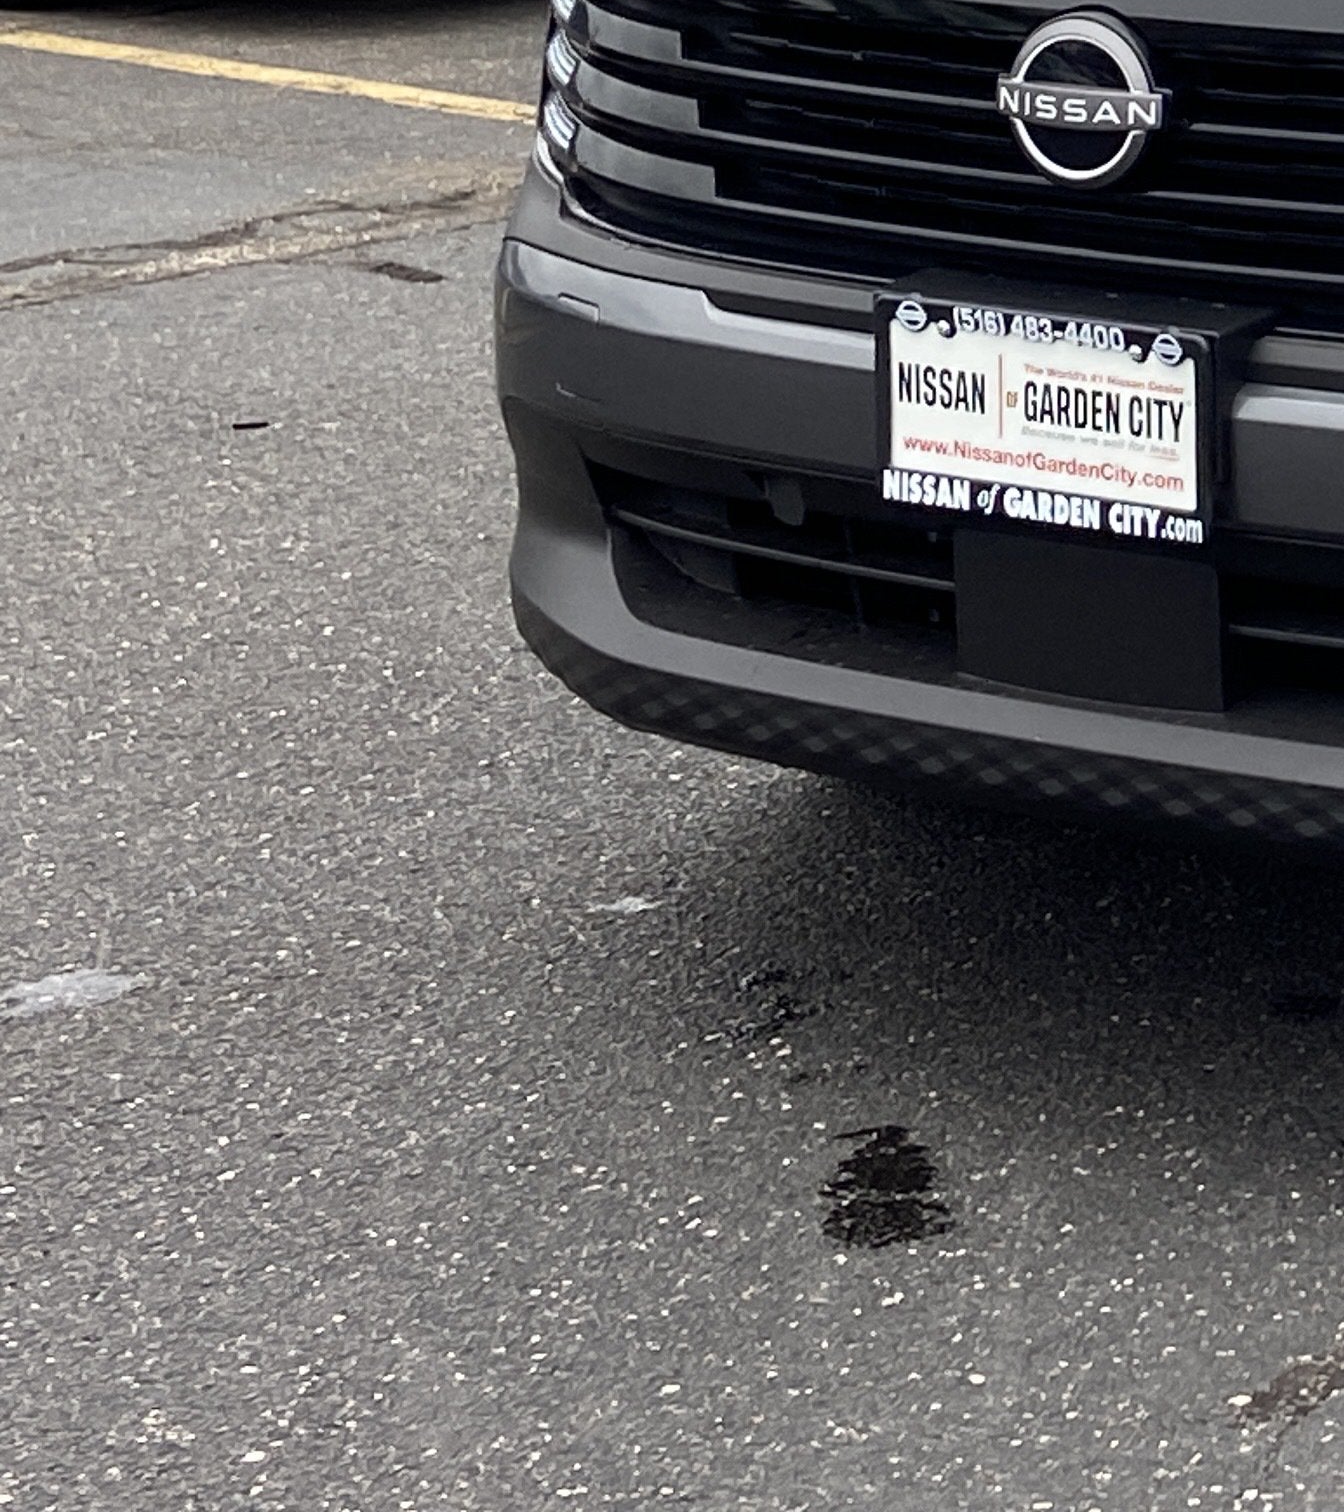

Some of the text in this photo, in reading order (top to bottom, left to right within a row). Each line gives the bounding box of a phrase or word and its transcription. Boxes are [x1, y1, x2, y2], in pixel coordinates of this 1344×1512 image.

[999, 86, 1156, 126] NISSAN
[953, 307, 1125, 352] (516) 483-4400
[899, 361, 986, 415] NISSAN
[1024, 380, 1120, 434] GARDEN
[1129, 395, 1184, 442] CITY
[903, 437, 1184, 490] www.NissanofGardenCity.com
[883, 469, 1203, 544] NISSAN of GARDEN CITY.com
